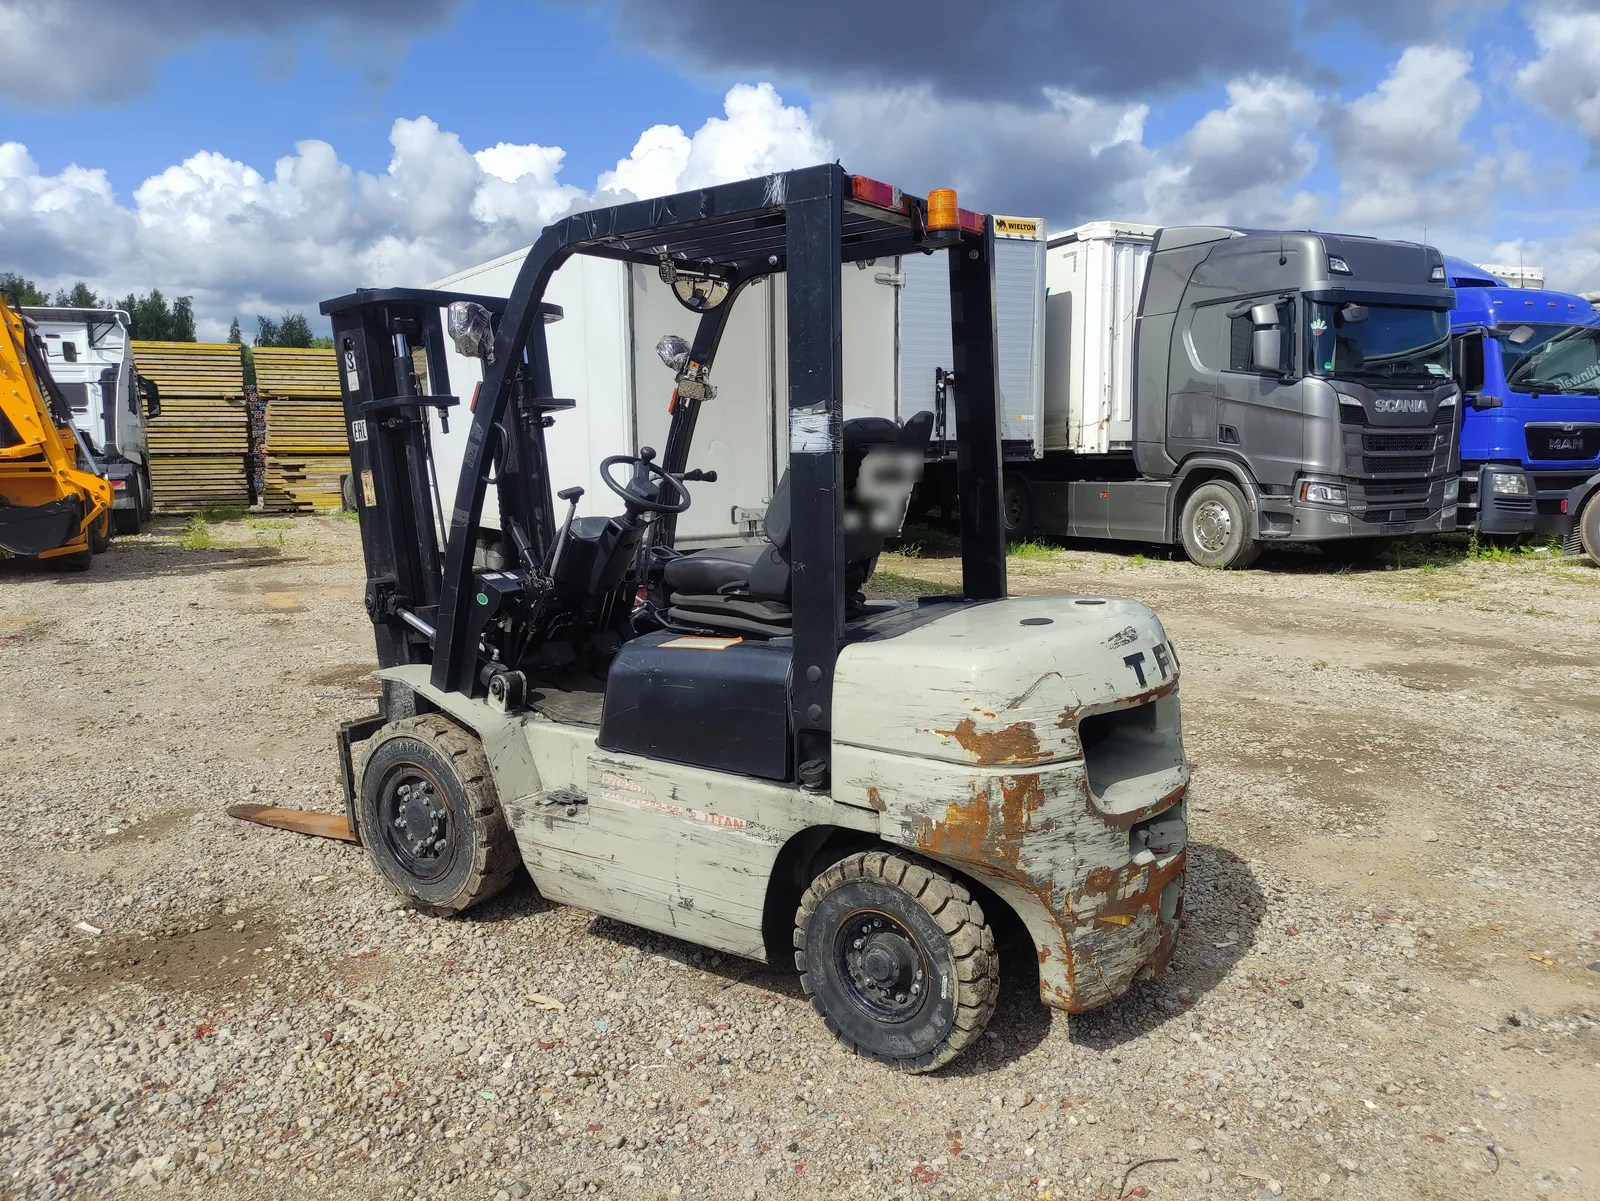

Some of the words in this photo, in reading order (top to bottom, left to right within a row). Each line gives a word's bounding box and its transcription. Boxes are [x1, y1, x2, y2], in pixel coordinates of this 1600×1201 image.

[1008, 223, 1036, 231] WIELTON
[1374, 399, 1428, 413] SCANIA
[1548, 438, 1584, 450] MAN
[1123, 640, 1179, 688] TF
